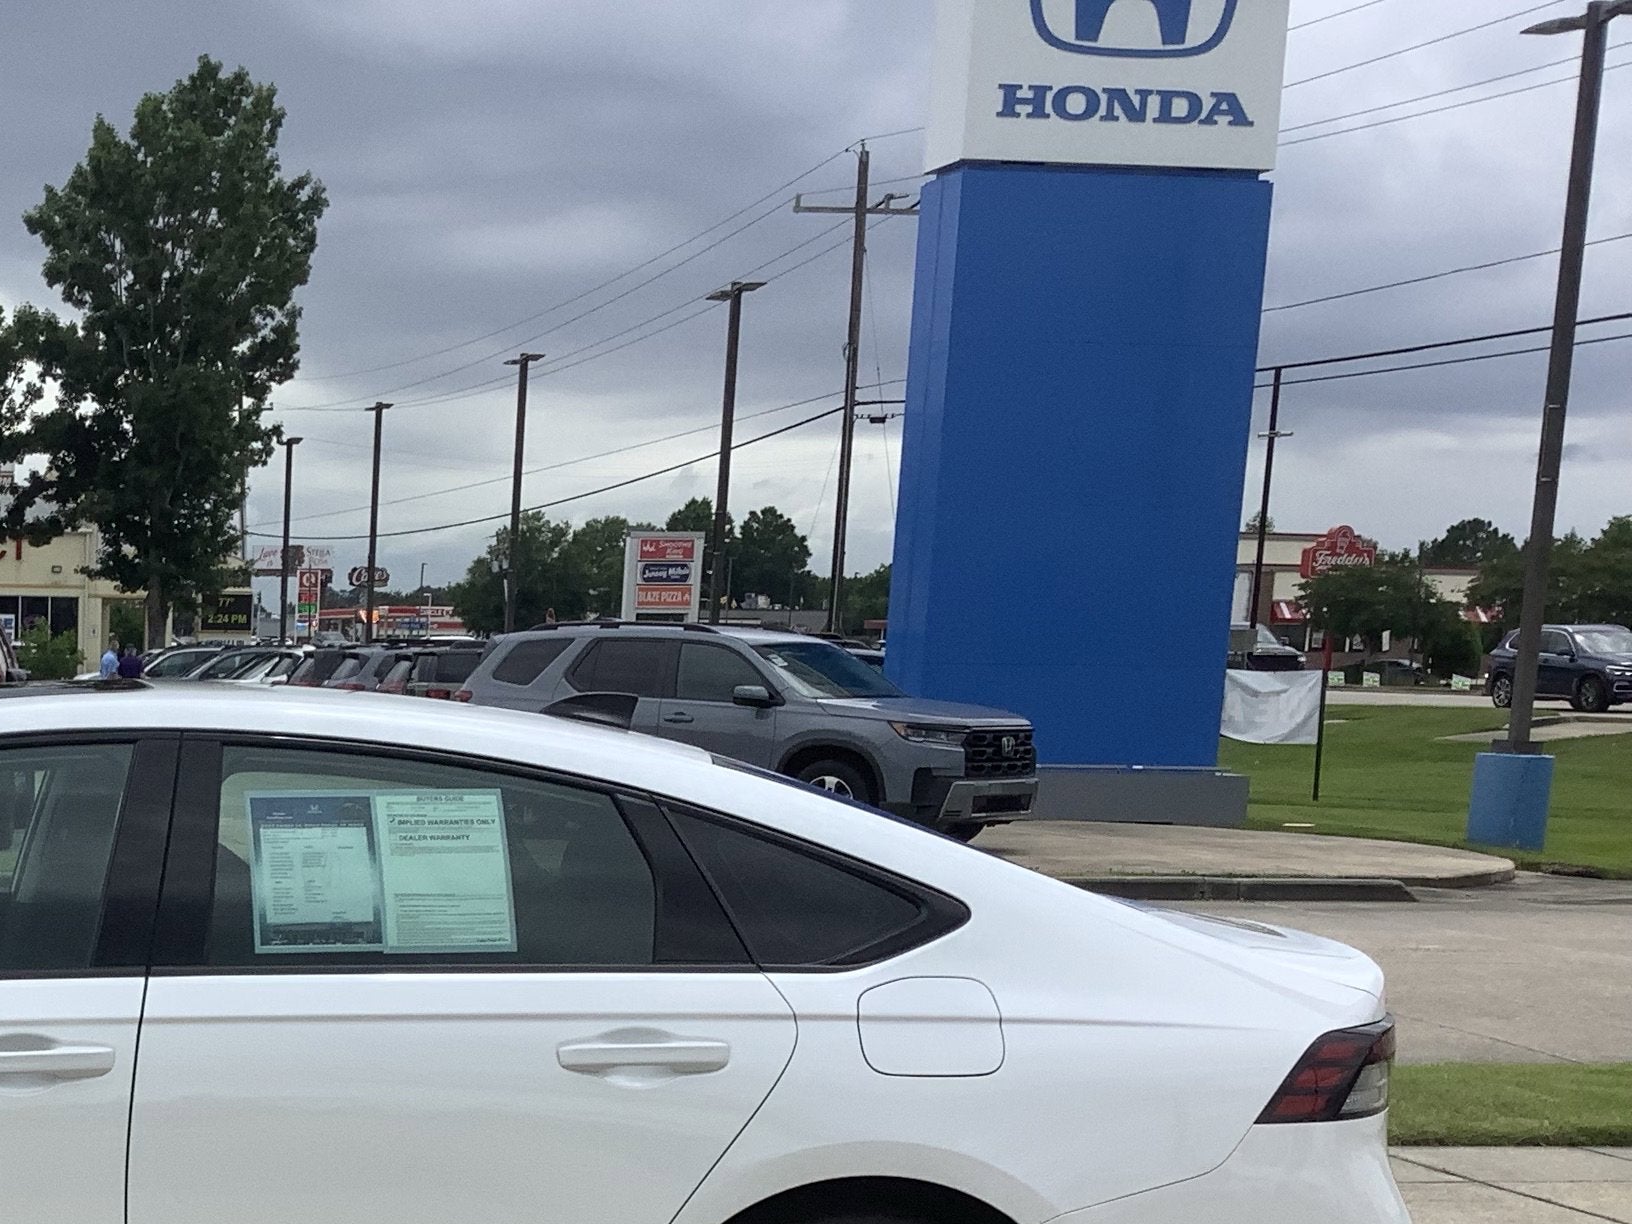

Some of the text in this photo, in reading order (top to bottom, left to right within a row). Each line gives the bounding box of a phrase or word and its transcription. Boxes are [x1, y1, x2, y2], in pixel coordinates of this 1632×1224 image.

[995, 83, 1255, 127] HONDA
[1312, 550, 1371, 567] Freddy's
[351, 567, 388, 586] Cae's
[638, 591, 682, 602] BLAZE PIZZA
[207, 613, 248, 624] 2:24 PM
